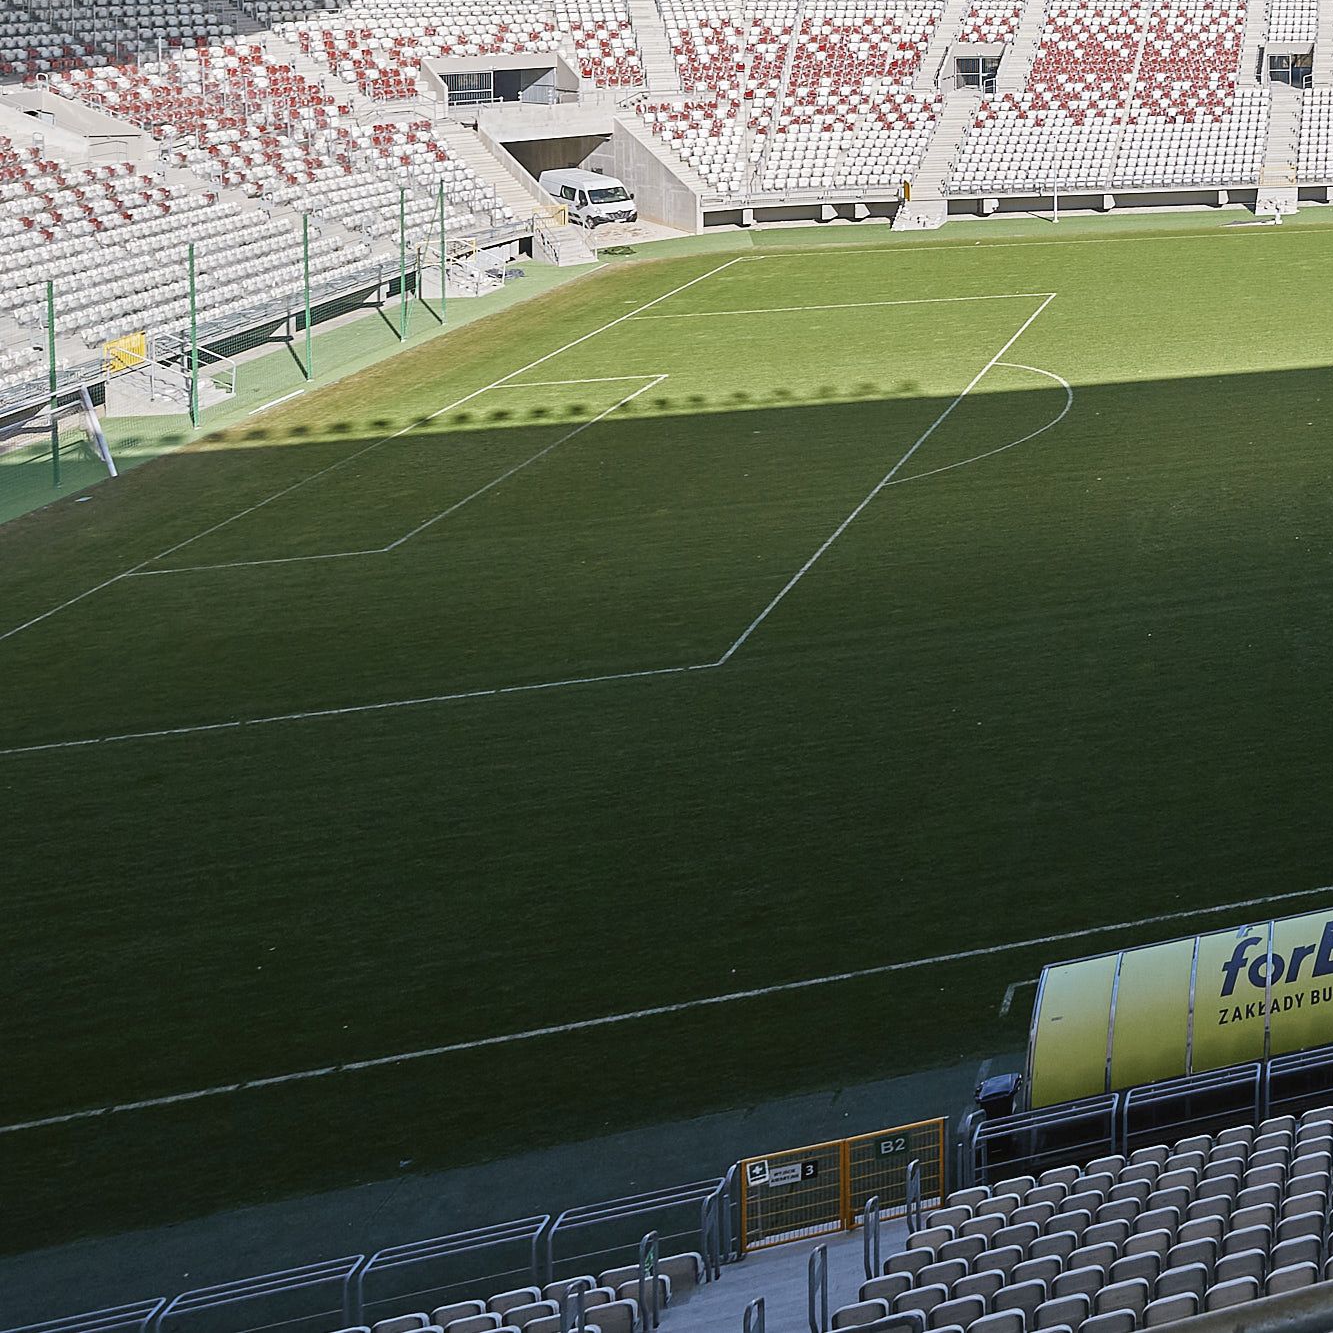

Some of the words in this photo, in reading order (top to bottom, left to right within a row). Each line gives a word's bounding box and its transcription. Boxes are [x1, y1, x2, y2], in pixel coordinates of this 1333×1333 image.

[1218, 992, 1304, 1025] ZAKŁADY
[880, 1138, 905, 1154] B2
[805, 1164, 814, 1176] 3
